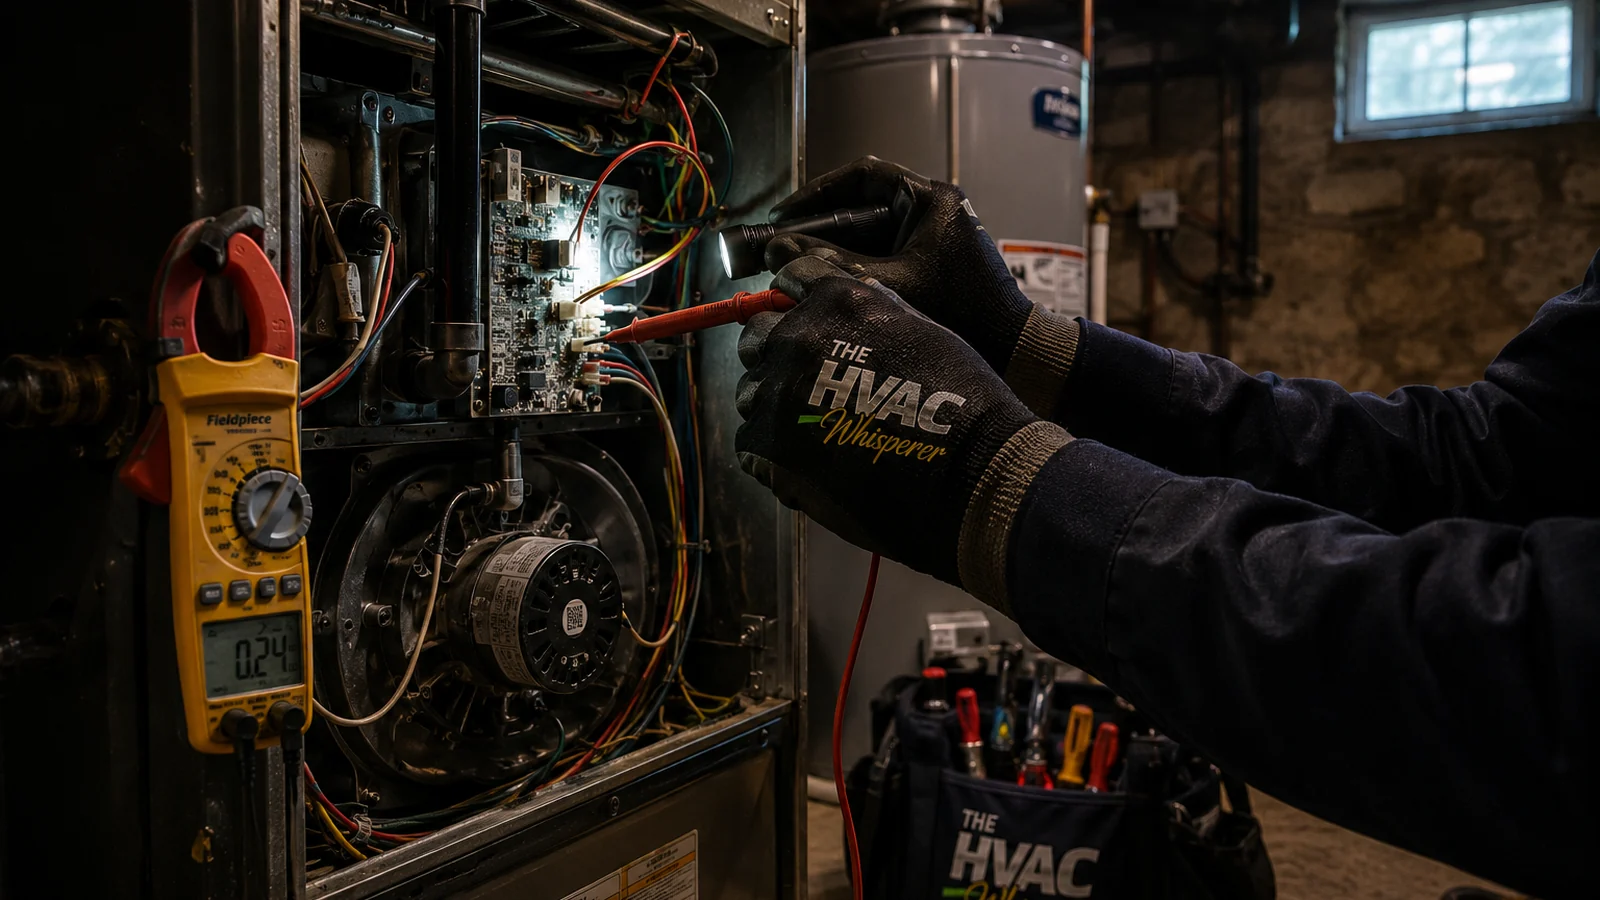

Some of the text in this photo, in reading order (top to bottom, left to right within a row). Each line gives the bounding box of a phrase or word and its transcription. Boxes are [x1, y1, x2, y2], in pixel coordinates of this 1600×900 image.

[832, 339, 873, 364] THE
[207, 413, 272, 427] Fieldpiece
[808, 359, 966, 435] HVAC
[820, 407, 947, 464] Whisperer
[235, 635, 288, 681] 0.24
[962, 808, 1000, 833] THE
[950, 831, 1100, 898] HVAC
